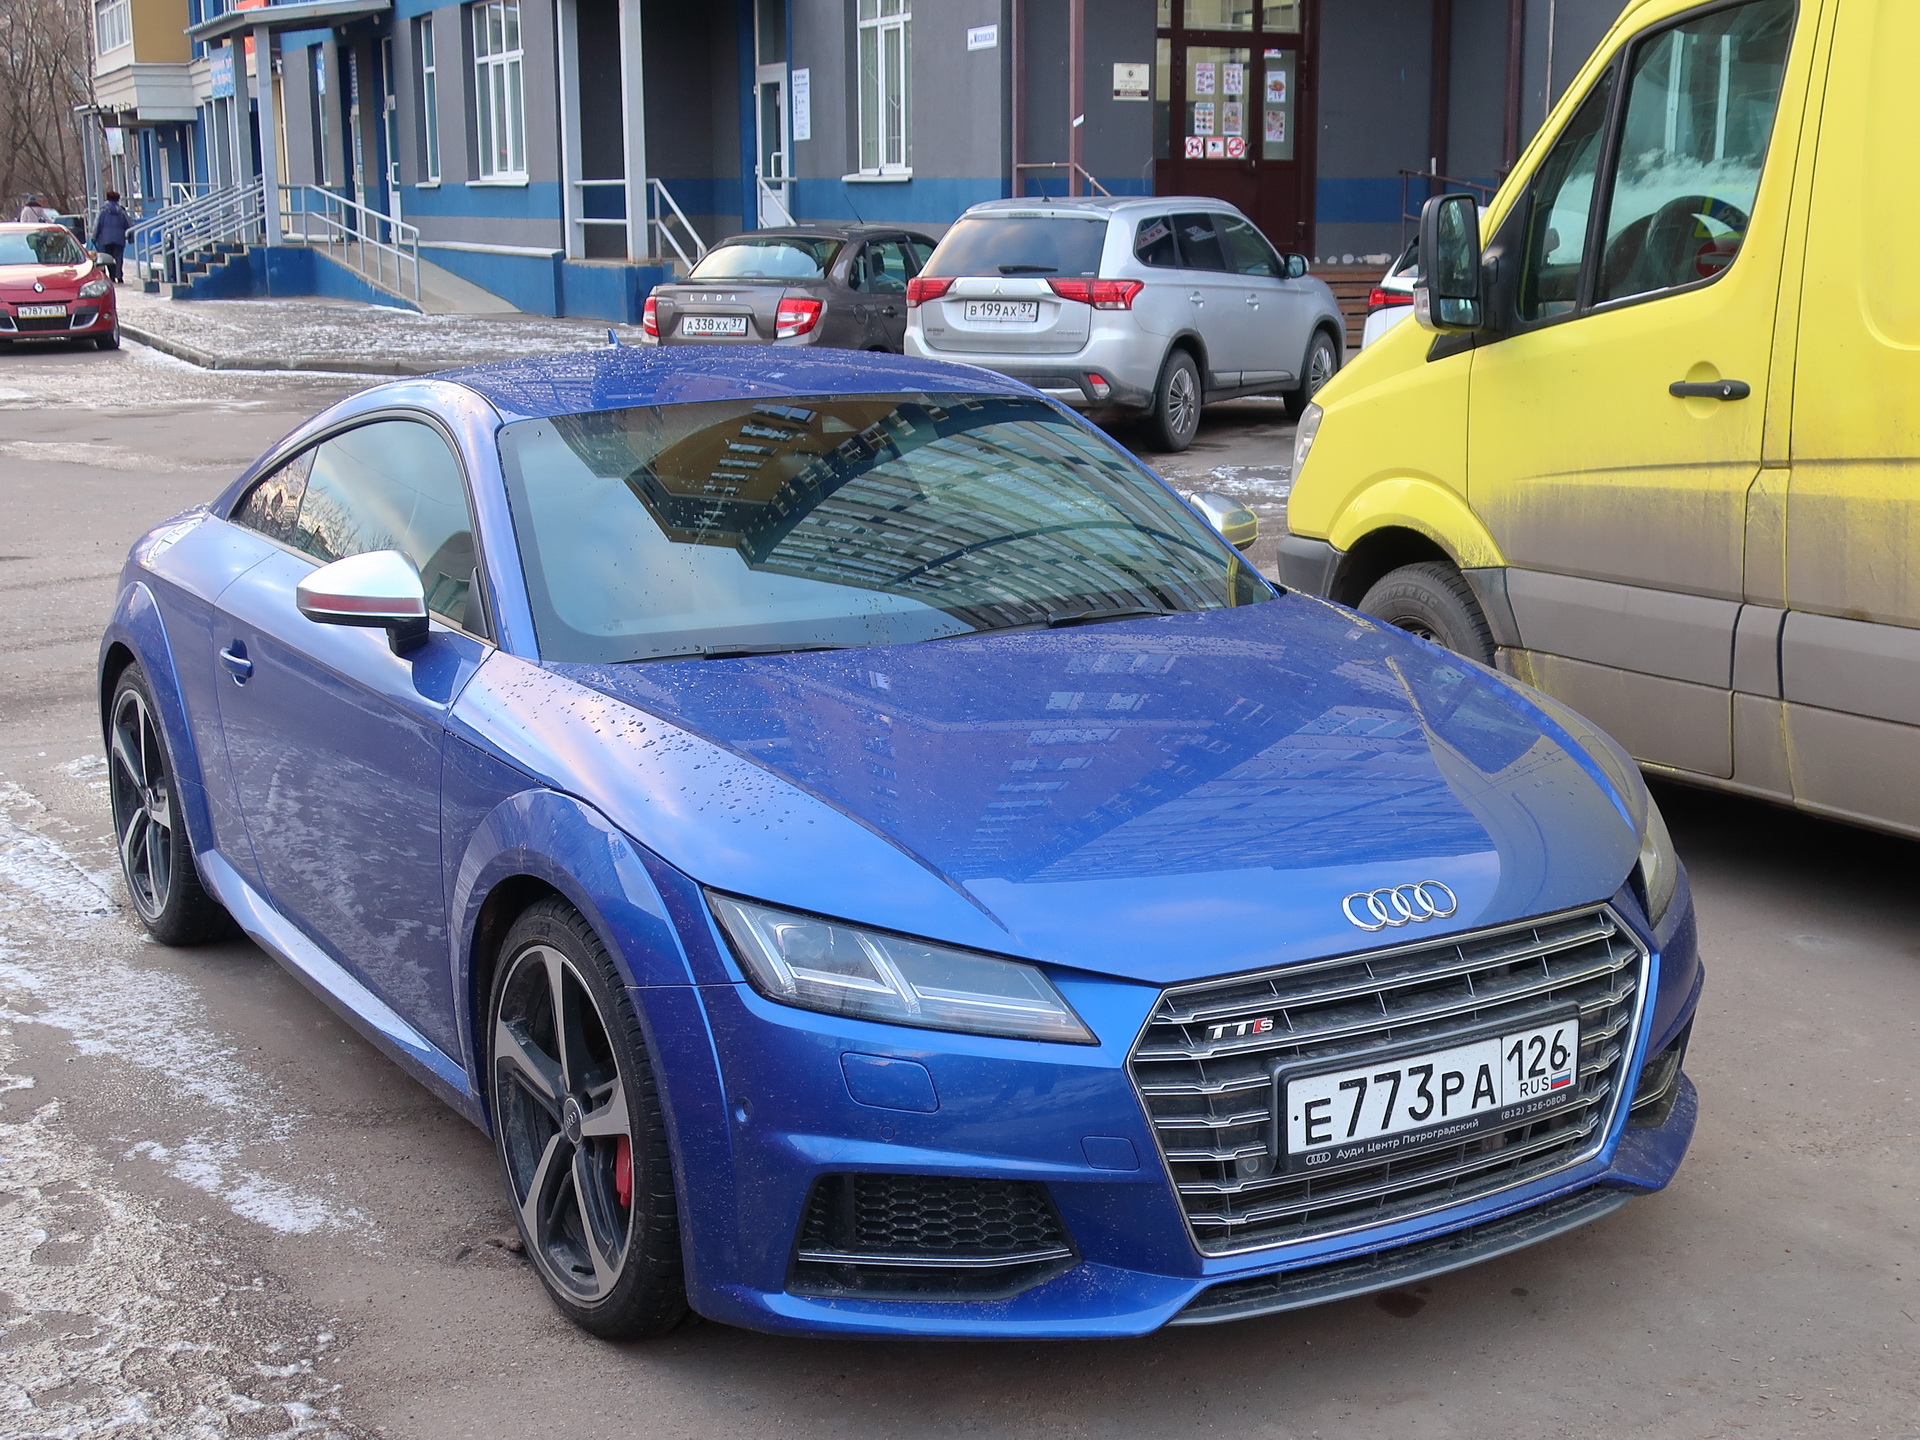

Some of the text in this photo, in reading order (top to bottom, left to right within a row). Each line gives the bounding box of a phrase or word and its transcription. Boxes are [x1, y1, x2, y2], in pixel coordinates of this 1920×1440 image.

[1020, 303, 1033, 313] 37
[687, 318, 743, 331] А338ХХ 37
[1208, 1018, 1273, 1040] TTS
[1304, 1028, 1568, 1146] Е773РА 126
[1519, 1076, 1549, 1098] RUS
[1336, 1094, 1567, 1159] Ауди Центр Петроградский (812) 326-0808
